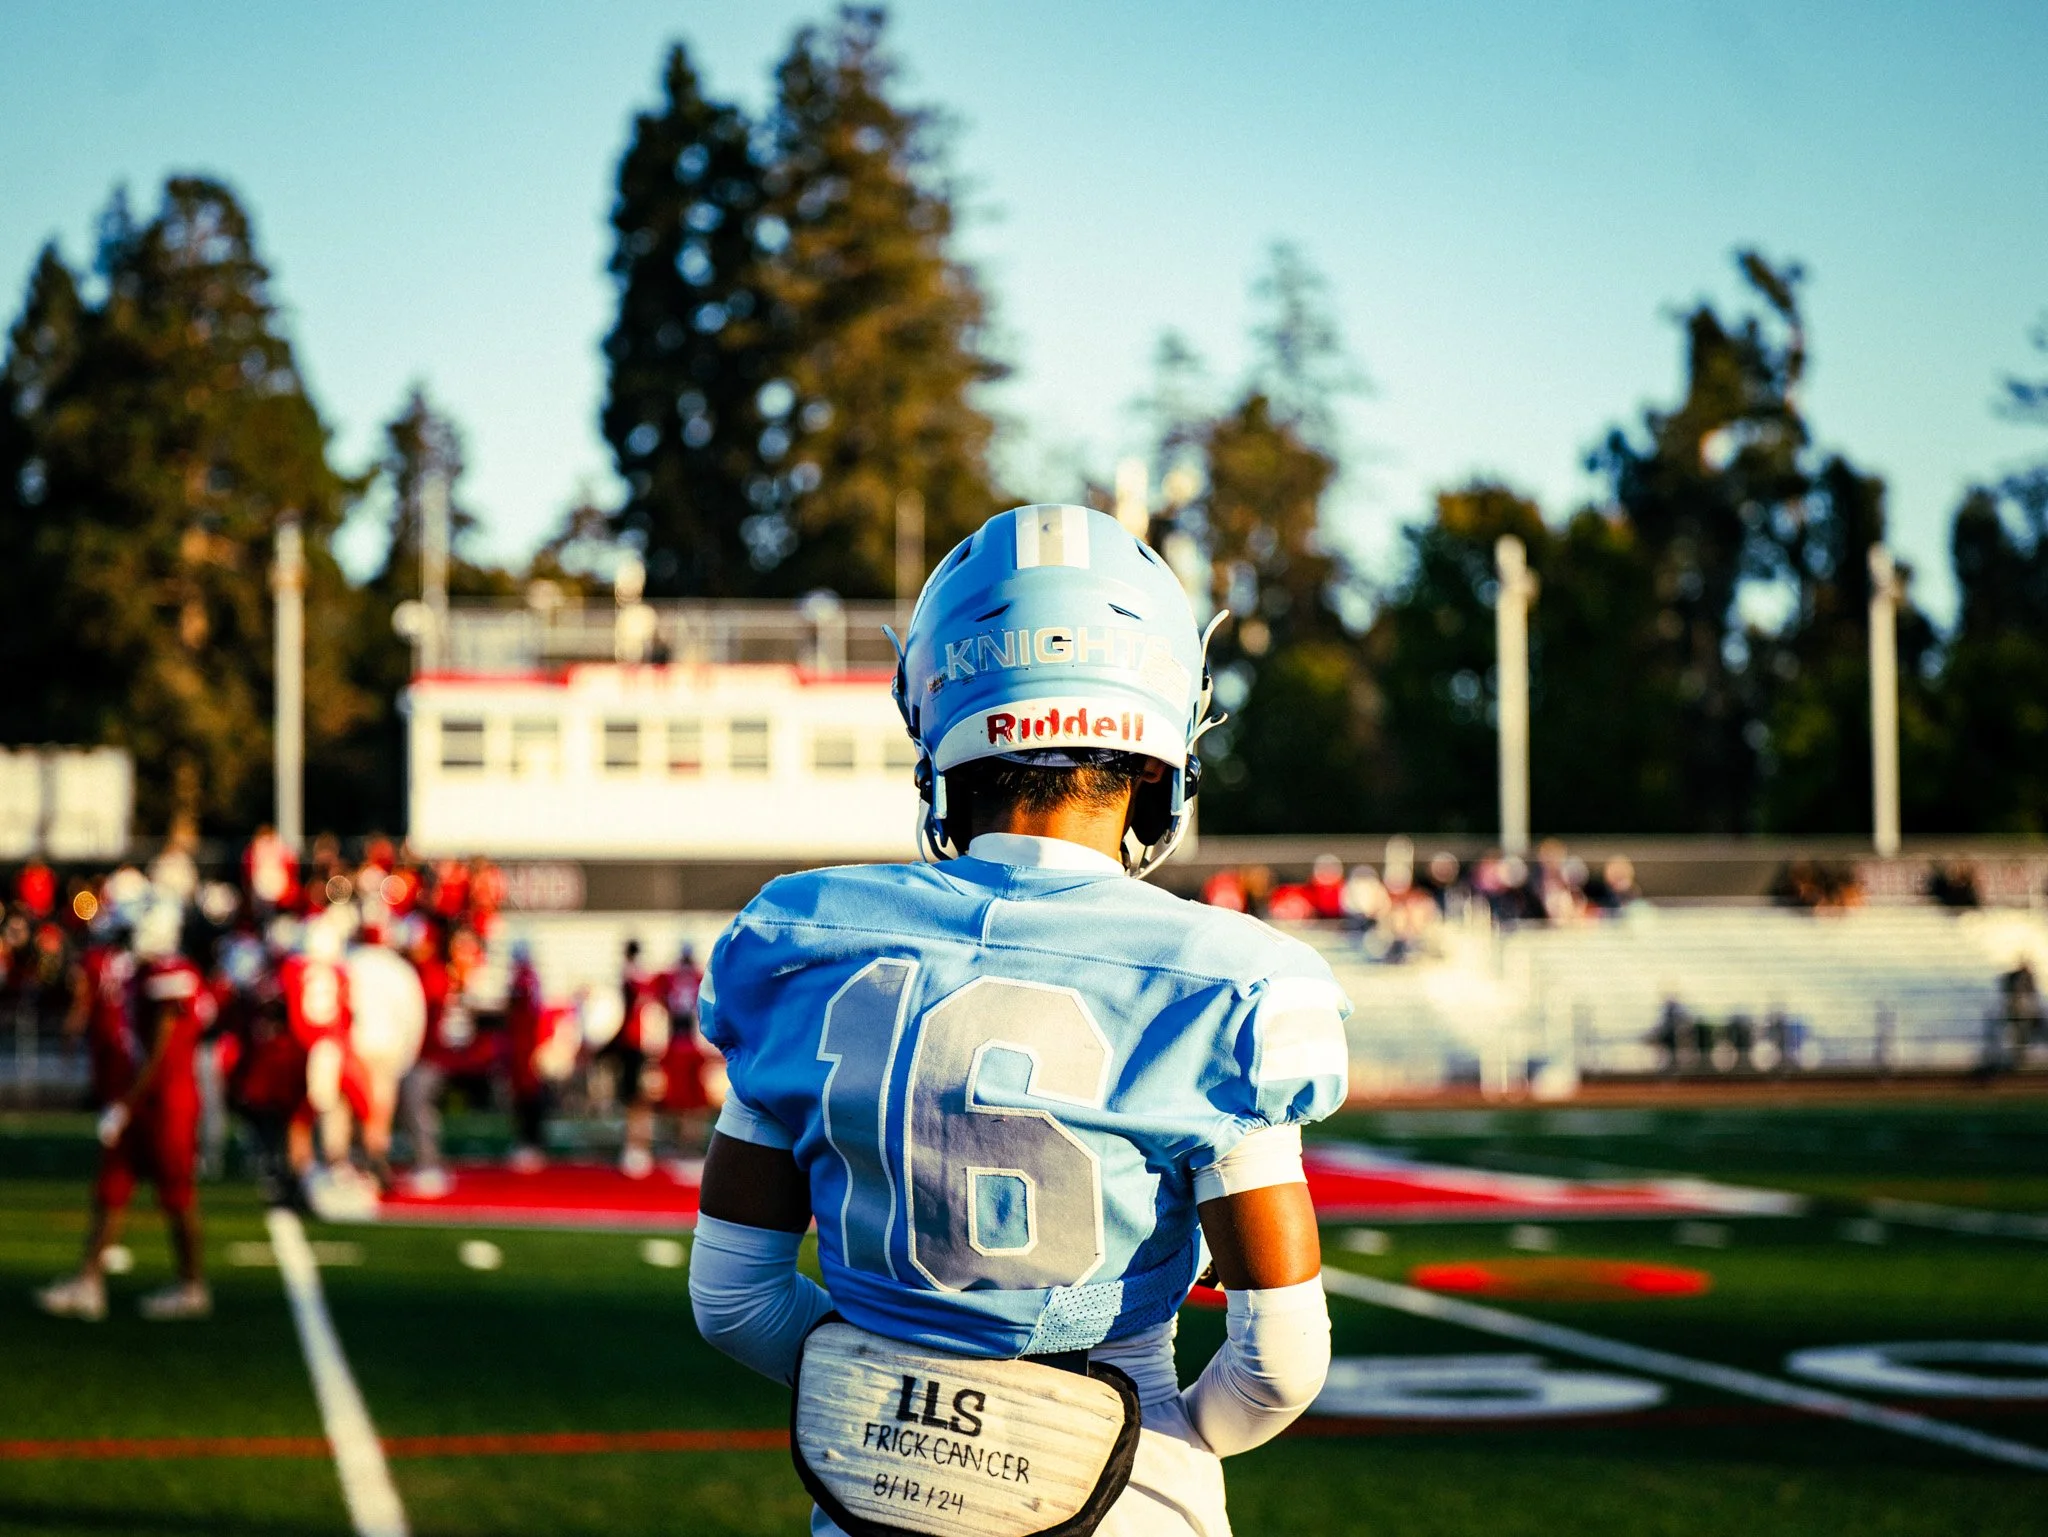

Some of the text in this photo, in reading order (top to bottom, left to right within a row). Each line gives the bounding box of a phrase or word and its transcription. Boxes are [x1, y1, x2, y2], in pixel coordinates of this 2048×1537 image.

[986, 707, 1145, 746] Riddell
[816, 956, 1115, 1293] 16
[895, 1374, 986, 1438] LLS
[863, 1422, 1030, 1484] FRICK CANCER
[873, 1472, 964, 1515] 8/12/24
